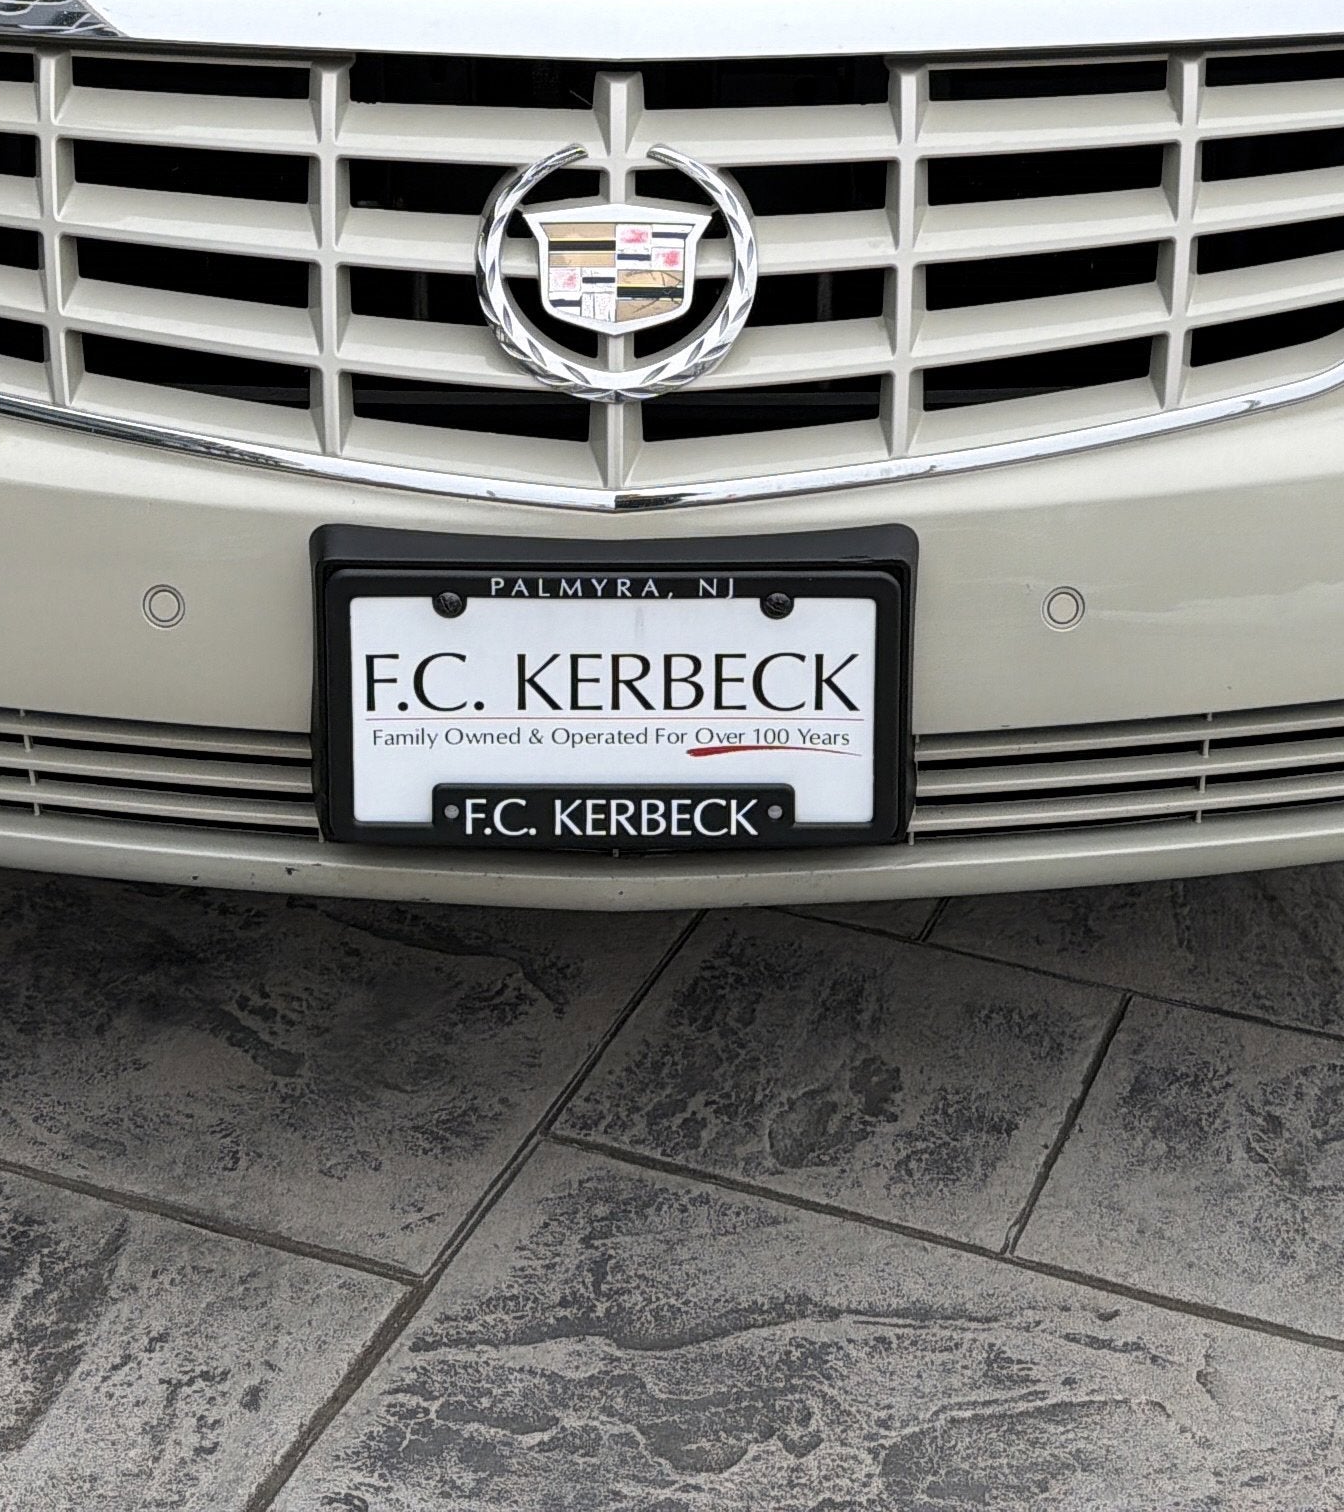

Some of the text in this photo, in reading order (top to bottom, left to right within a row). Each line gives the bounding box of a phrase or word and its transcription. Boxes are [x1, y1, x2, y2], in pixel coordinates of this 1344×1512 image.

[490, 577, 736, 599] PALMYRA, NJ
[364, 652, 861, 712] F.C. KERBECK
[372, 727, 850, 750] Family Owned & Operated For Over 100 Years
[464, 798, 758, 837] F.C. KERBECK
